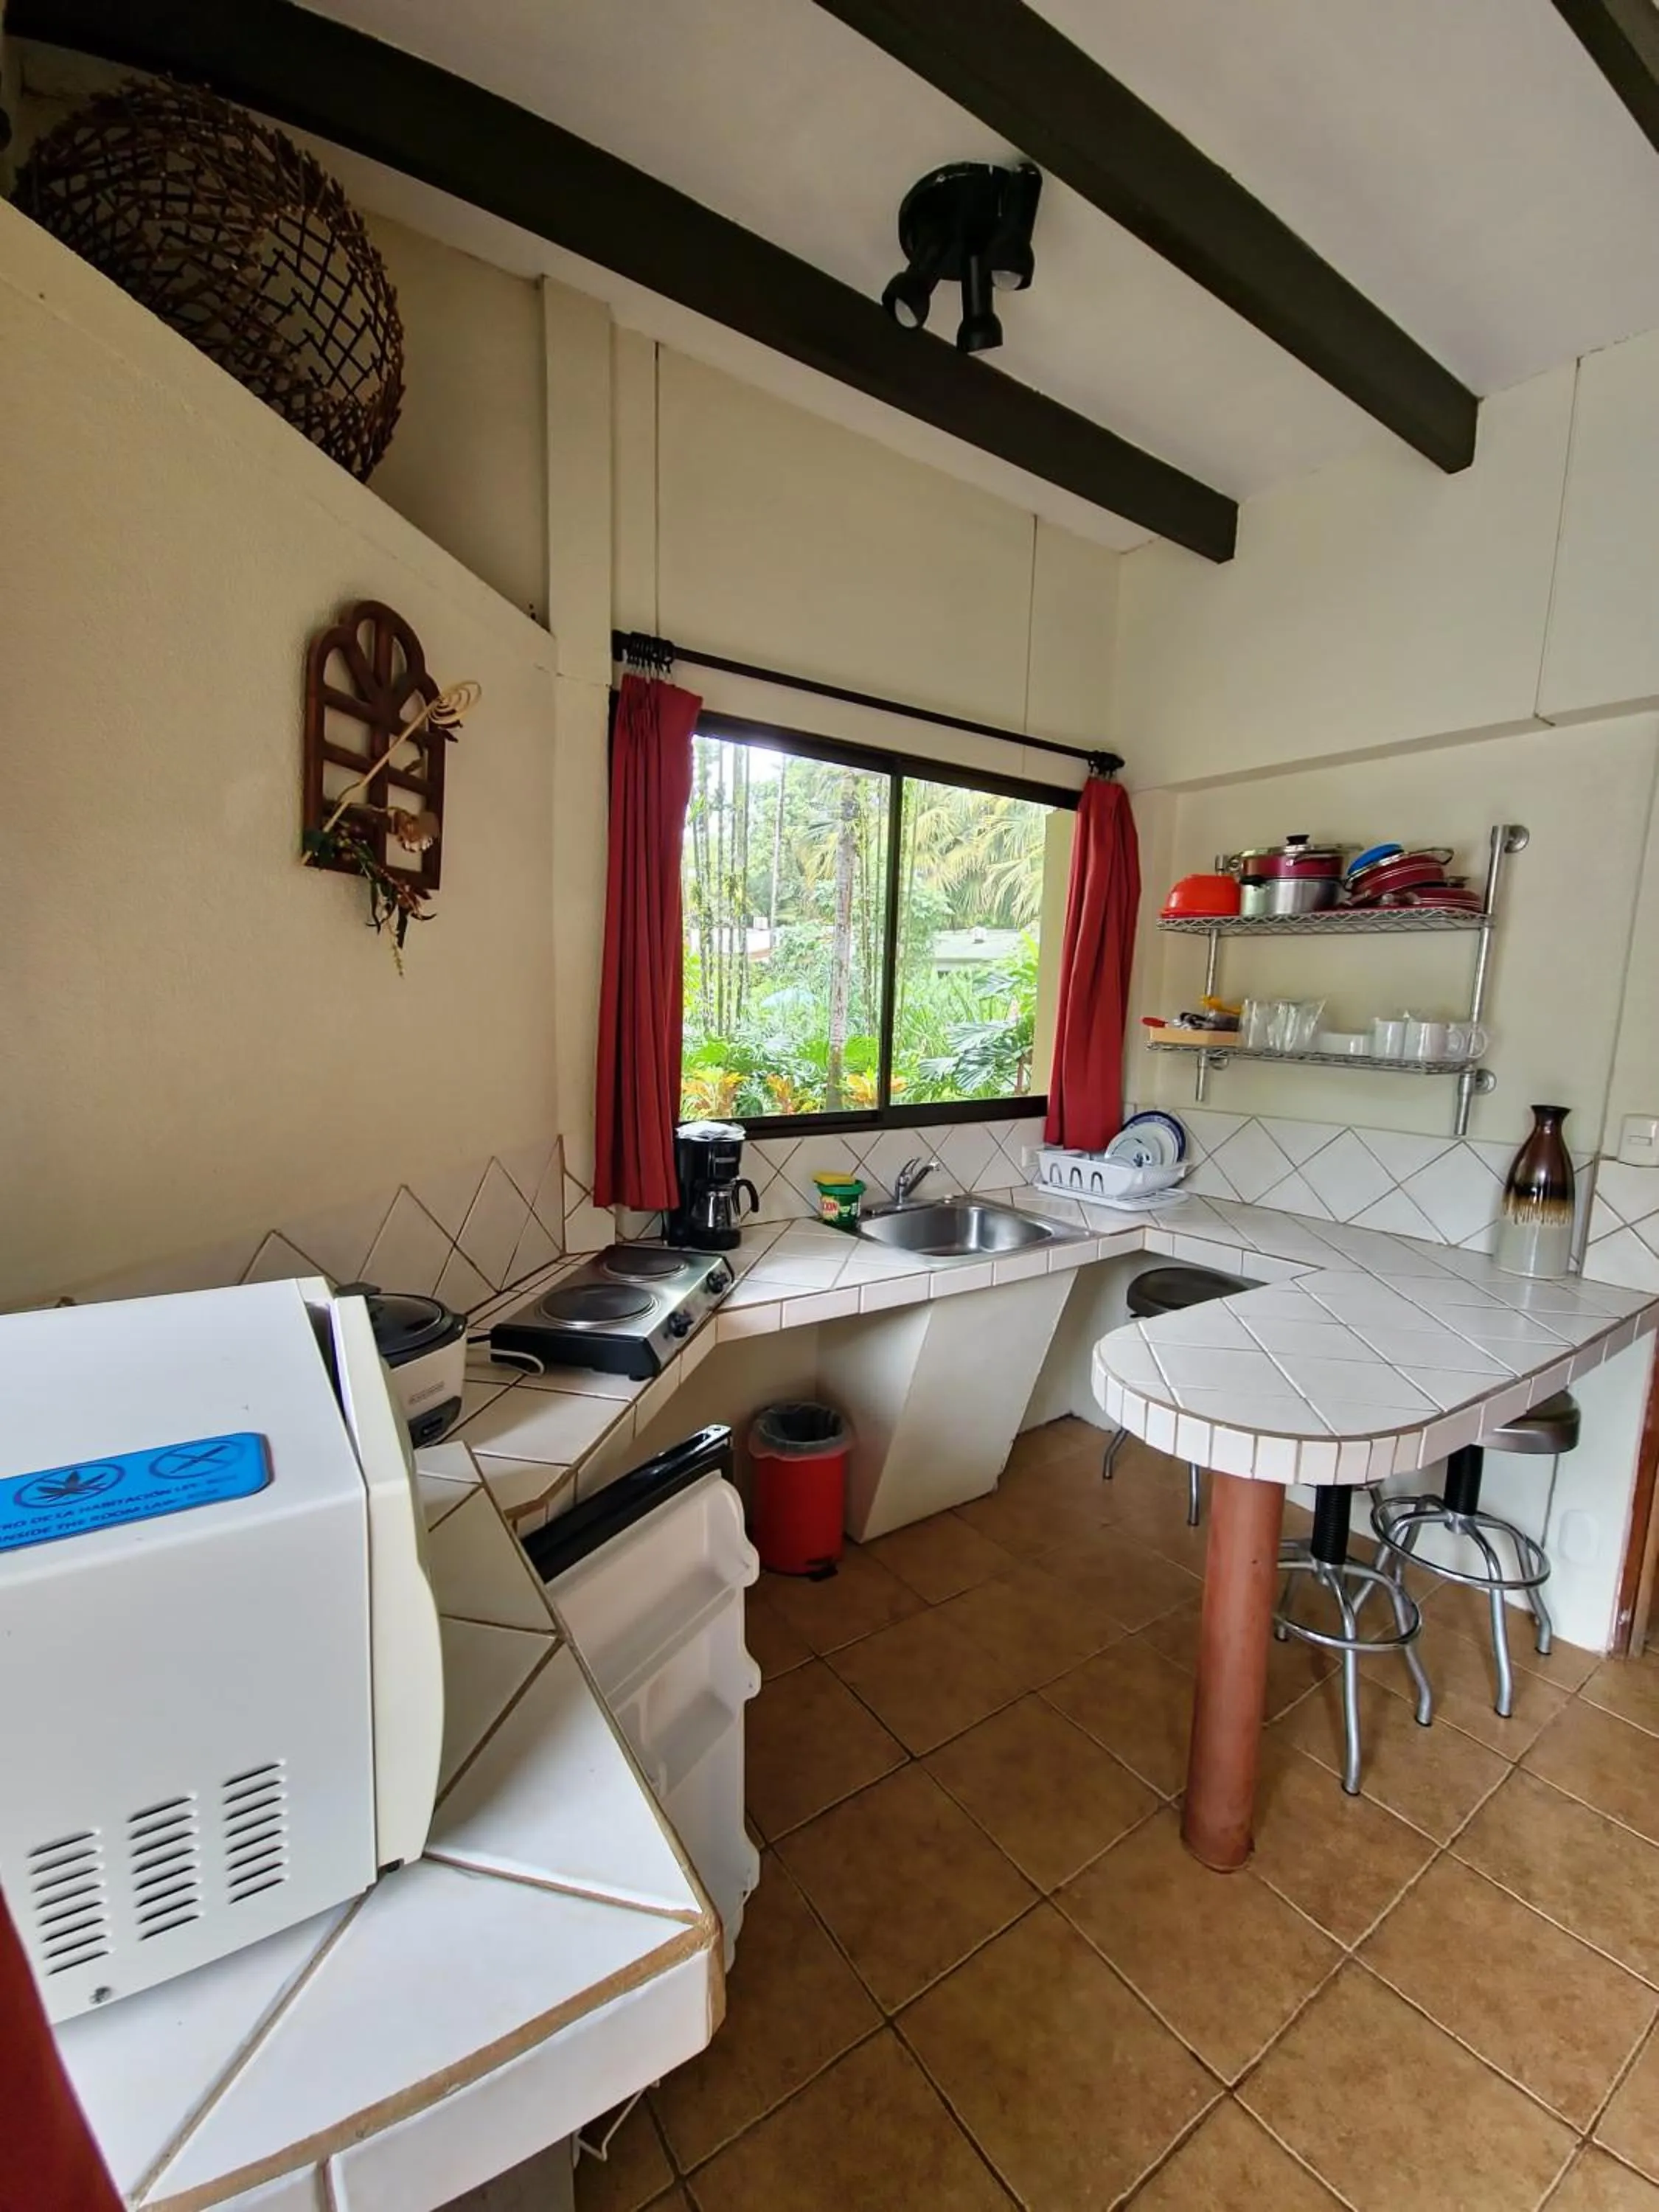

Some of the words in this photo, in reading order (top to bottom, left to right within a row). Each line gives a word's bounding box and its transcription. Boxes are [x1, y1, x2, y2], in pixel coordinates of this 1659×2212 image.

[0, 1520, 27, 1531] RO
[31, 1514, 53, 1525] DE
[57, 1520, 84, 1531] THE
